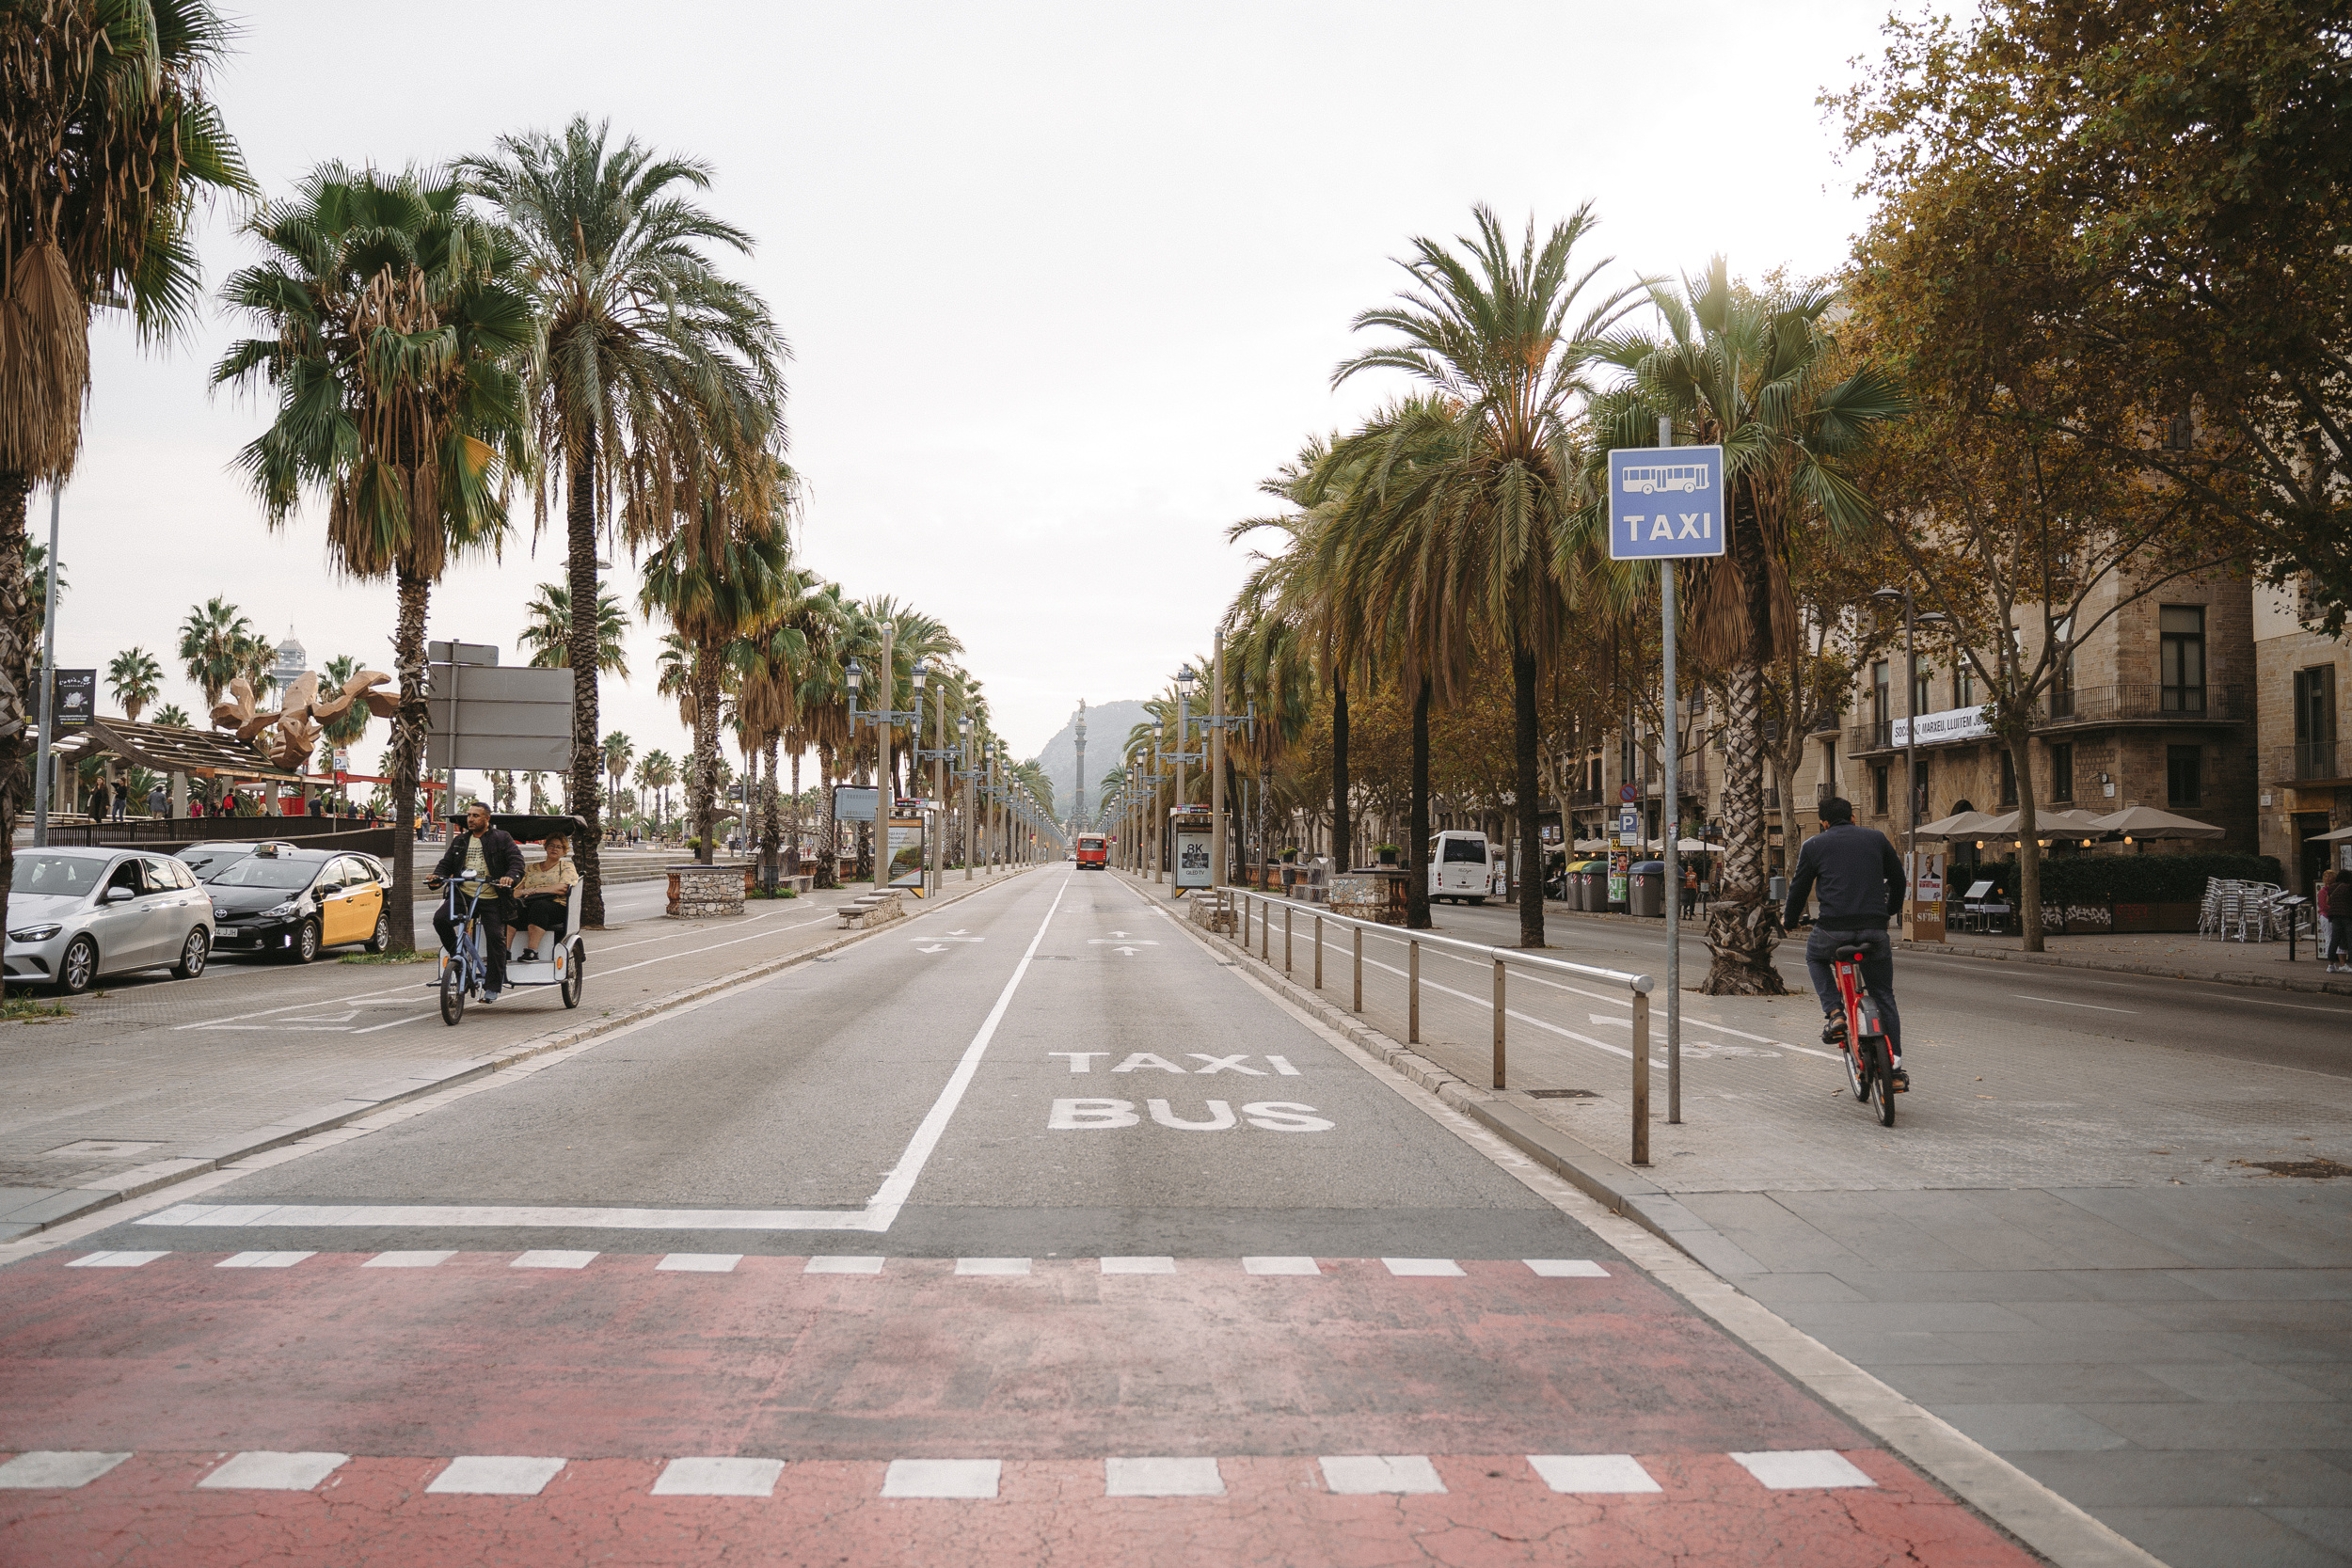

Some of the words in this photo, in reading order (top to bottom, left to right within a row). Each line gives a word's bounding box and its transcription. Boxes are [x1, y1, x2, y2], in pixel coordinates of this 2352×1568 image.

[1623, 512, 1710, 542] TAXI
[1922, 719, 1947, 734] MARXEU,
[1947, 715, 1972, 730] LLUITEM
[335, 759, 342, 769] P
[1623, 816, 1633, 830] P
[1187, 844, 1203, 853] 8K
[1048, 1052, 1301, 1075] TAXI
[1047, 1098, 1337, 1132] BUS
